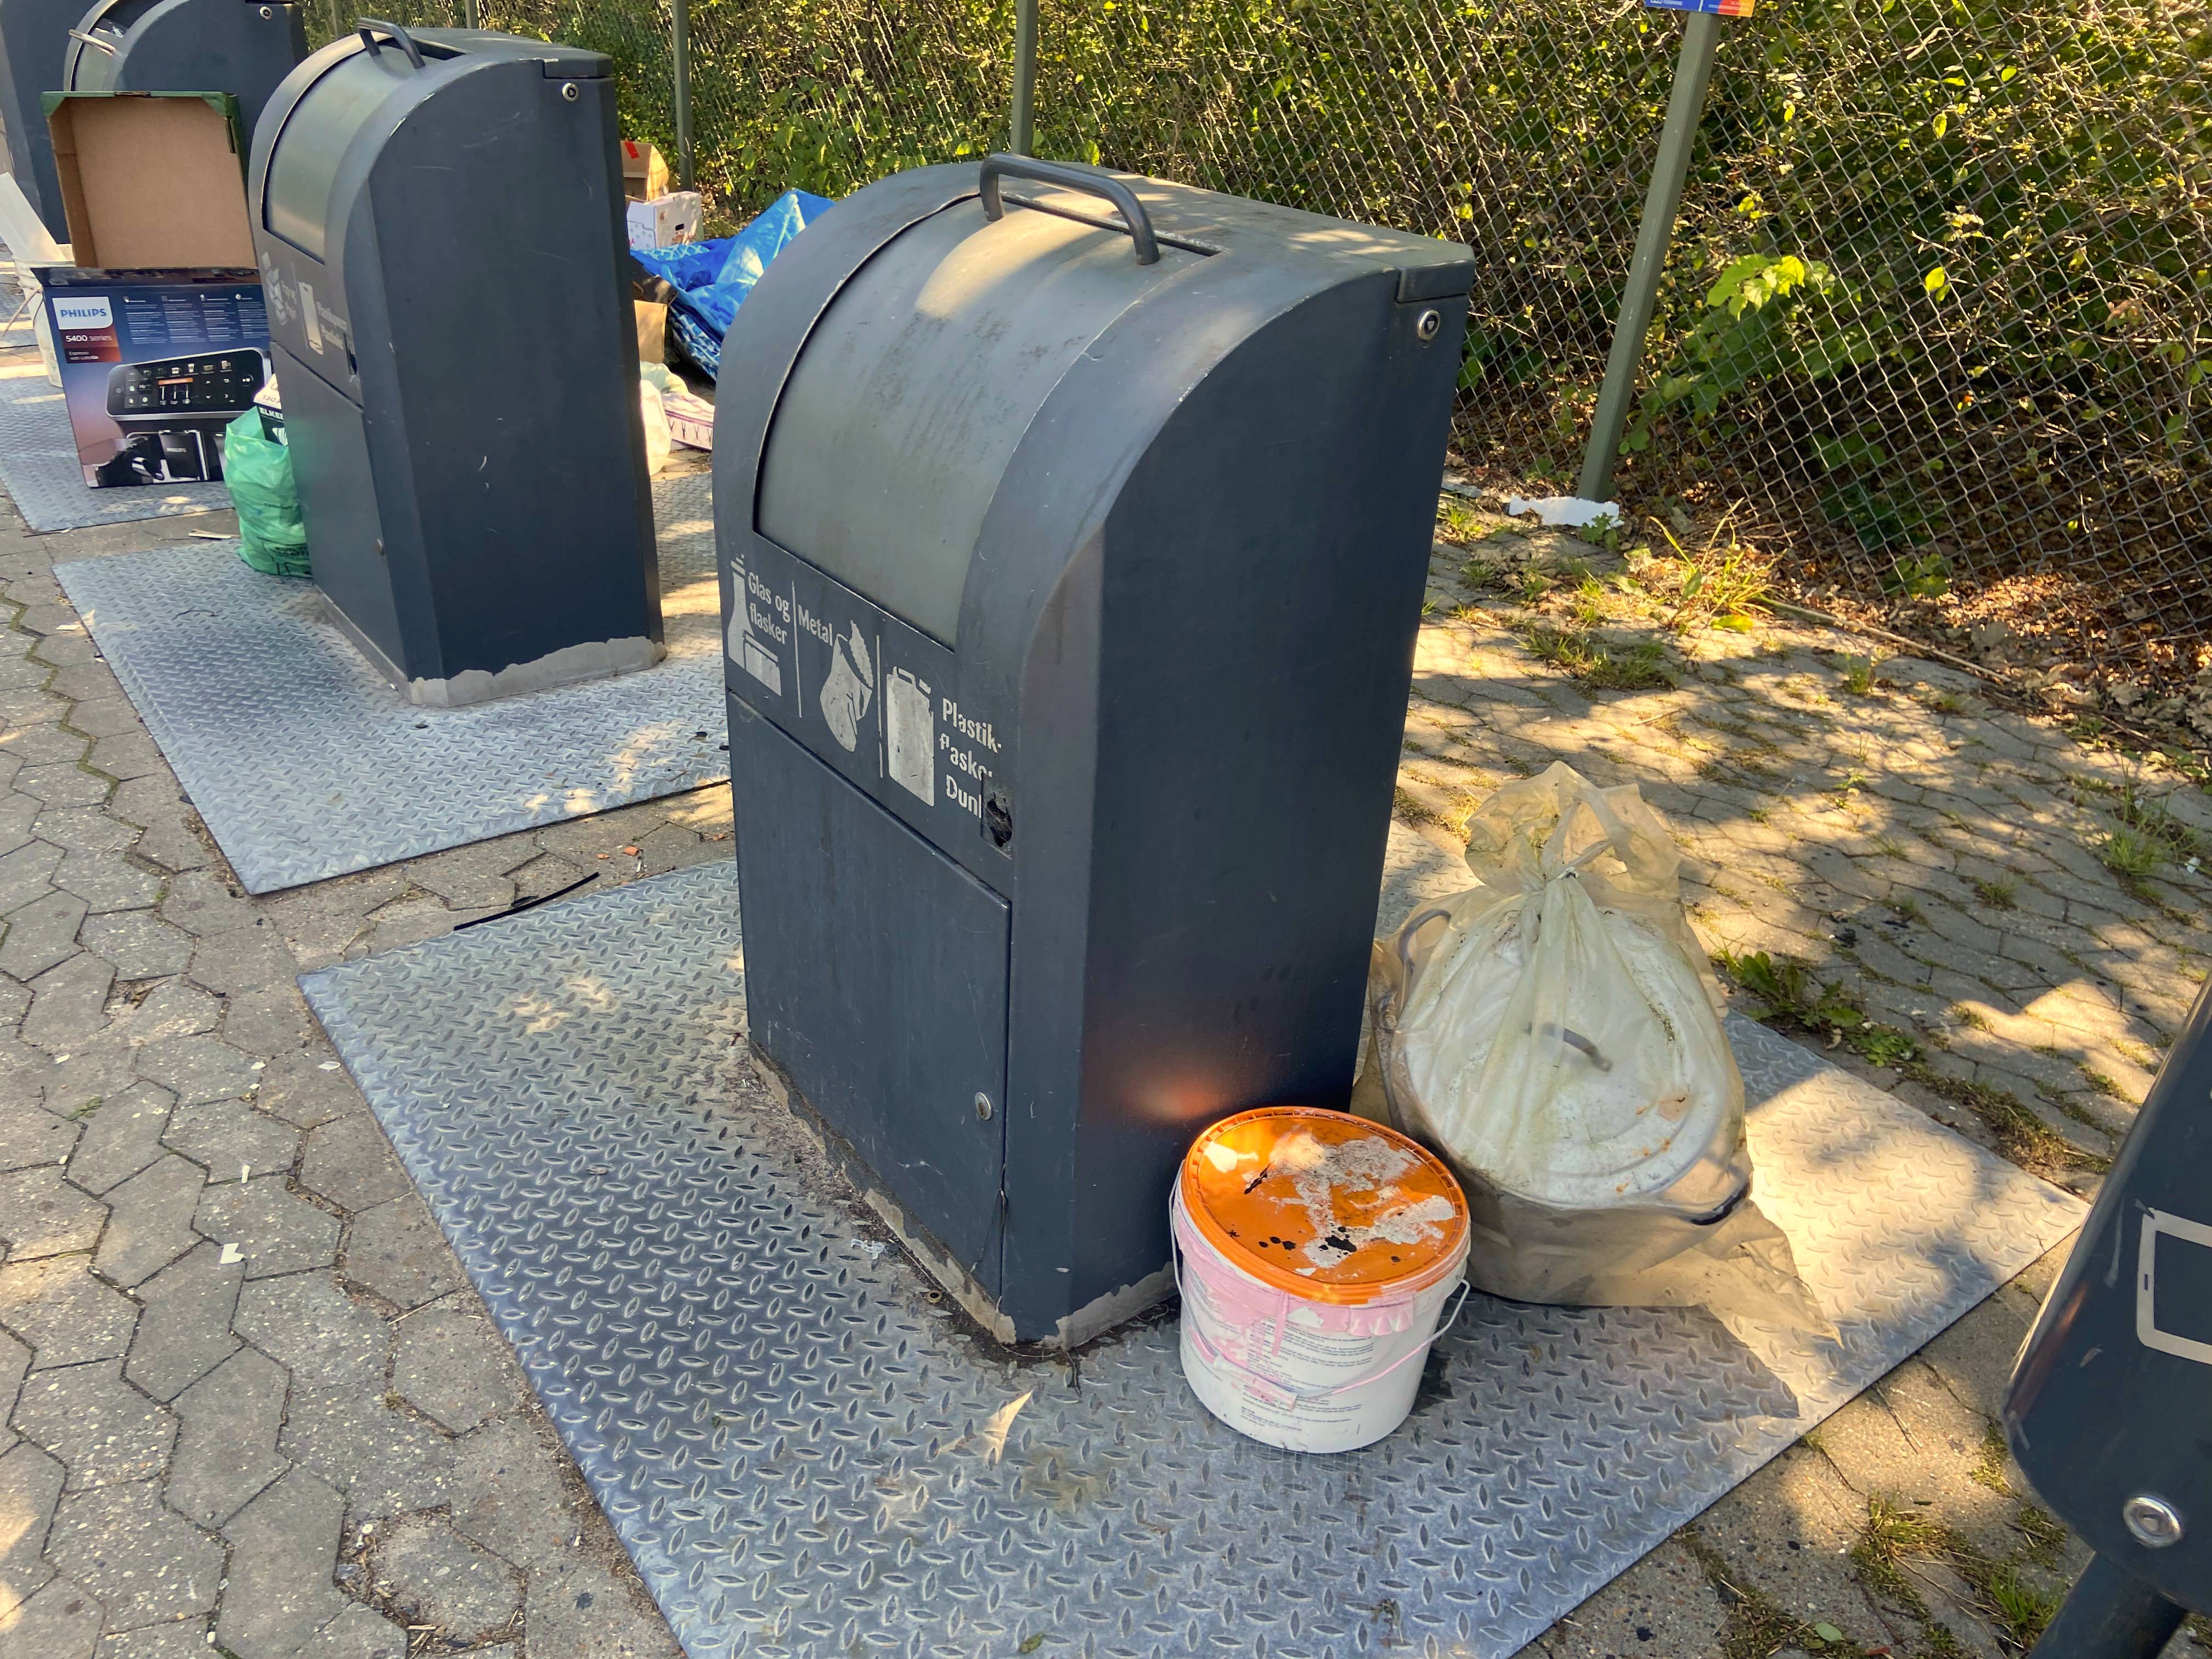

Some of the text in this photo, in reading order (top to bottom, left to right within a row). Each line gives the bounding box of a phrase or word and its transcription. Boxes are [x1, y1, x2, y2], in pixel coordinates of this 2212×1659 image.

[60, 308, 106, 317] PHILIPS
[748, 572, 791, 623] Glas og
[749, 602, 787, 645] flasker
[798, 605, 833, 647] Metal
[943, 697, 1002, 754] Plastik-
